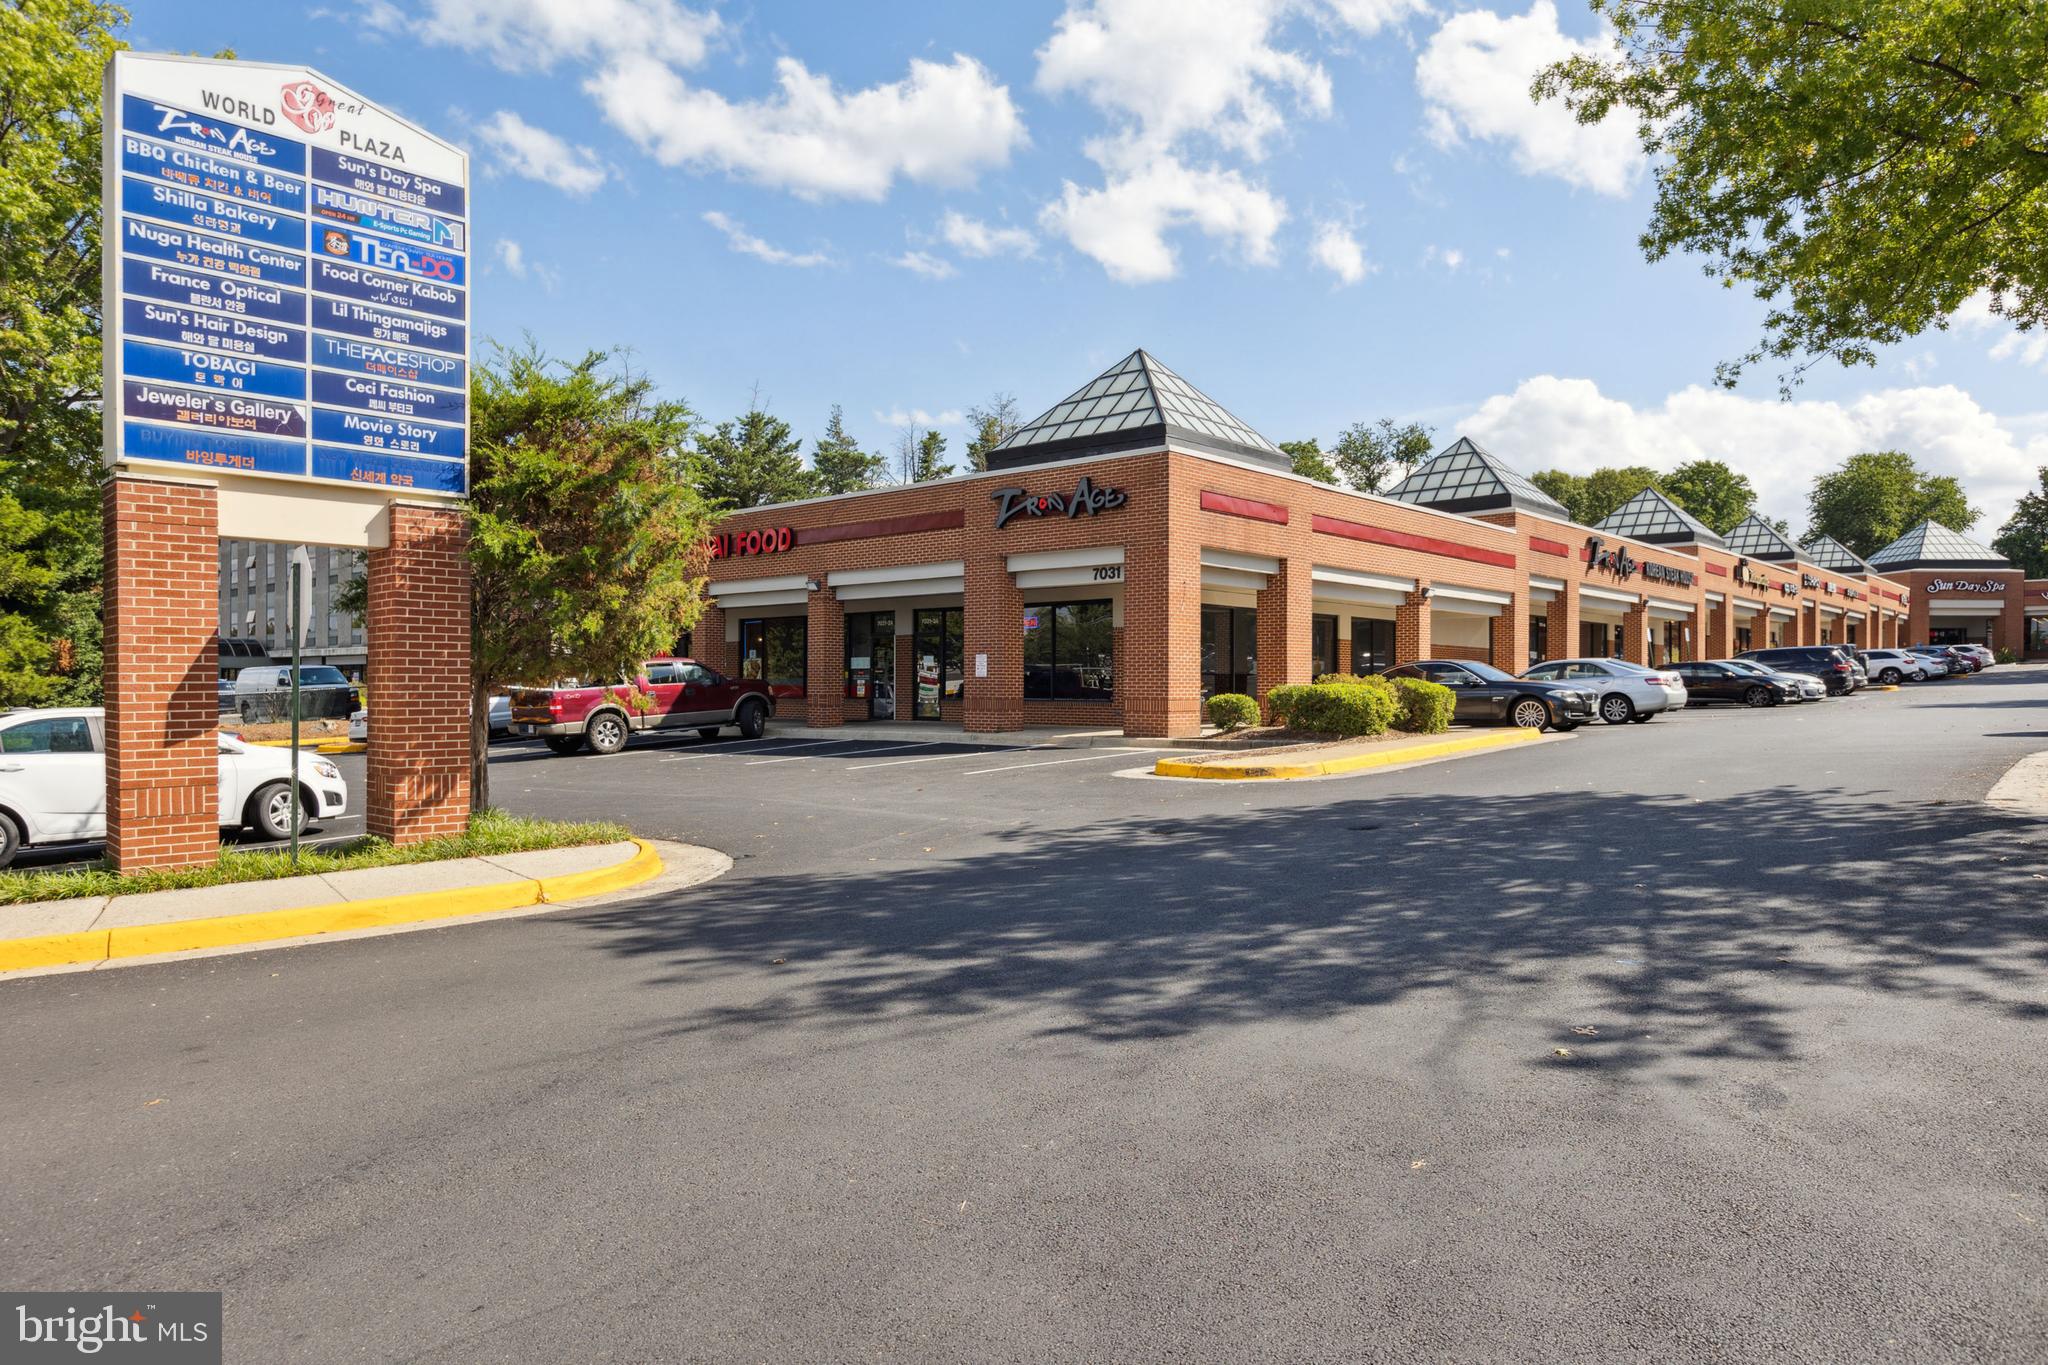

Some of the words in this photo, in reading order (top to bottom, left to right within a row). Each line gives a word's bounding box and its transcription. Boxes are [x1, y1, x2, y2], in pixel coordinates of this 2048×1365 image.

[317, 91, 367, 116] Great
[202, 90, 275, 125] WORLD
[340, 130, 405, 163] PLAZA
[175, 135, 206, 151] KOREAN
[208, 144, 232, 158] STEAK
[233, 151, 258, 164] HOUSE
[126, 138, 166, 162] BBQ
[172, 151, 240, 180] Chicken
[246, 170, 258, 185] &
[264, 174, 301, 195] Beer
[338, 156, 377, 178] Sun's
[380, 168, 411, 189] Day
[414, 179, 441, 197] Spa
[153, 187, 208, 212] Shilla
[214, 201, 277, 231] Bakery
[318, 189, 432, 231] HUNTER
[129, 222, 182, 247] Nuga
[187, 234, 244, 259] Health
[248, 250, 302, 272] Center
[408, 230, 431, 241] Gaming
[151, 266, 211, 291] France
[220, 281, 281, 304] Optical
[322, 263, 358, 283] Food
[362, 273, 409, 292] Corner
[412, 283, 457, 303] Kabob
[145, 305, 189, 325] Sun's
[193, 313, 230, 332] Hair
[234, 320, 288, 344] Design
[332, 302, 348, 318] Lil
[352, 306, 448, 338] Thingamajigs
[181, 351, 256, 376] TOBAGI
[346, 378, 376, 395] Ceci
[380, 384, 435, 404] Fashion
[230, 400, 292, 424] Gallery
[344, 416, 393, 434] Movie
[398, 423, 437, 443] Story
[351, 468, 386, 484] 신세계
[391, 474, 414, 487] 약국
[736, 527, 792, 556] FOOD
[1093, 566, 1121, 581] 7031
[1927, 579, 1954, 593] Sun
[1955, 580, 1981, 592] Day
[1980, 579, 2006, 593] Spa
